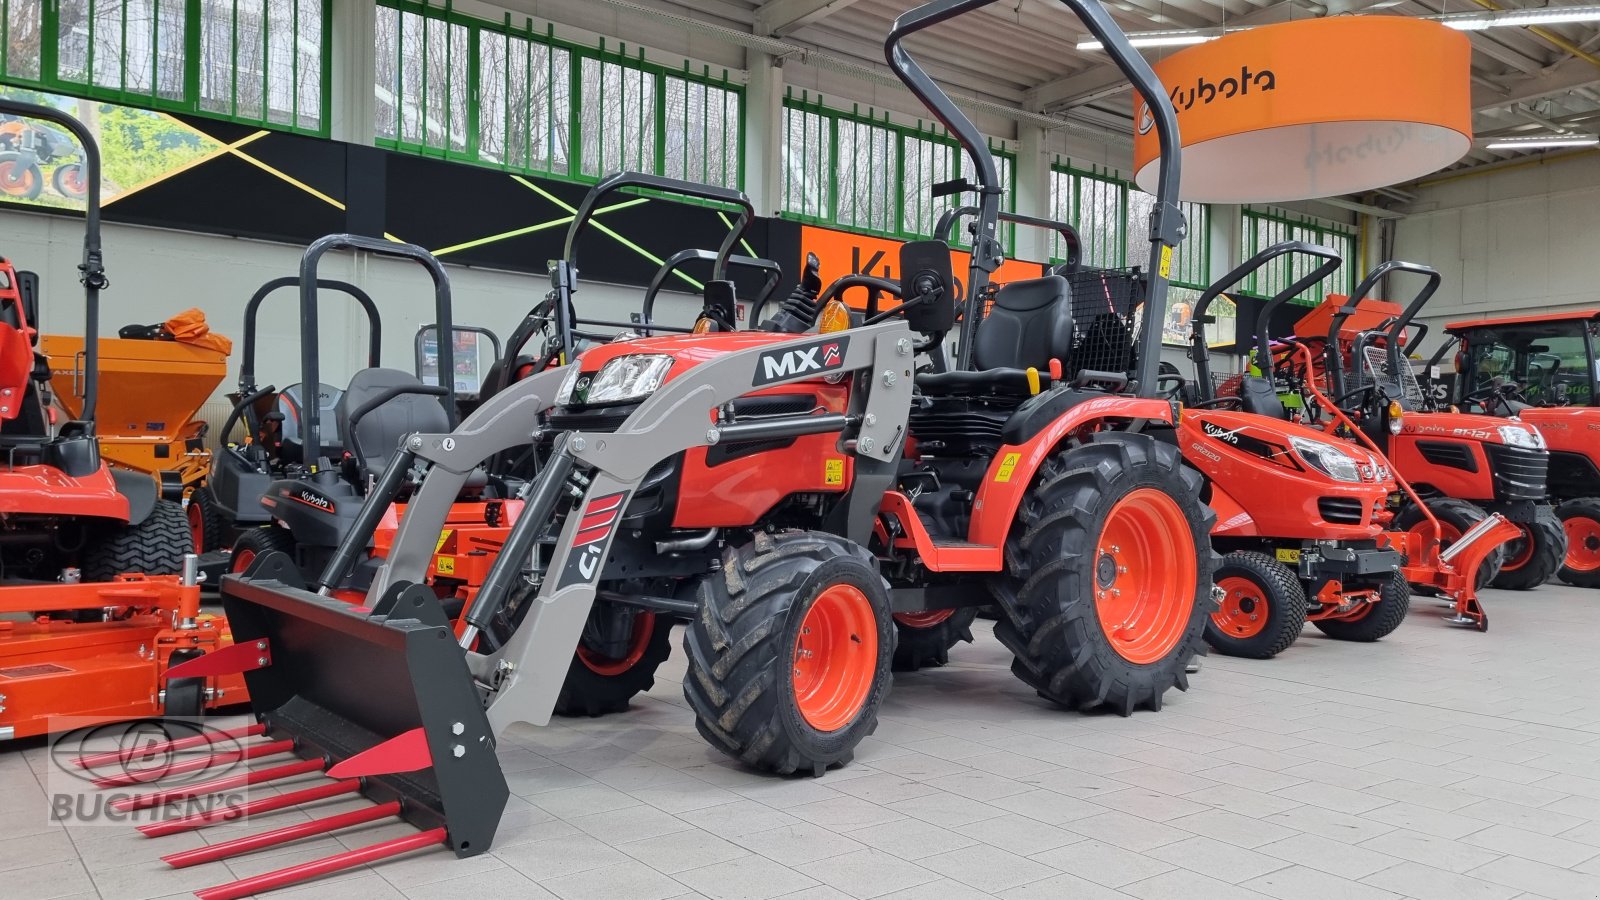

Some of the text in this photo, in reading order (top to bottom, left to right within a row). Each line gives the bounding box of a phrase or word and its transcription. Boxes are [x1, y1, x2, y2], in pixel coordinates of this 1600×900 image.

[763, 346, 821, 379] MX
[1204, 422, 1239, 445] Kubota
[1192, 443, 1222, 462] GR2120
[302, 490, 328, 508] Kubota
[579, 544, 602, 580] C1
